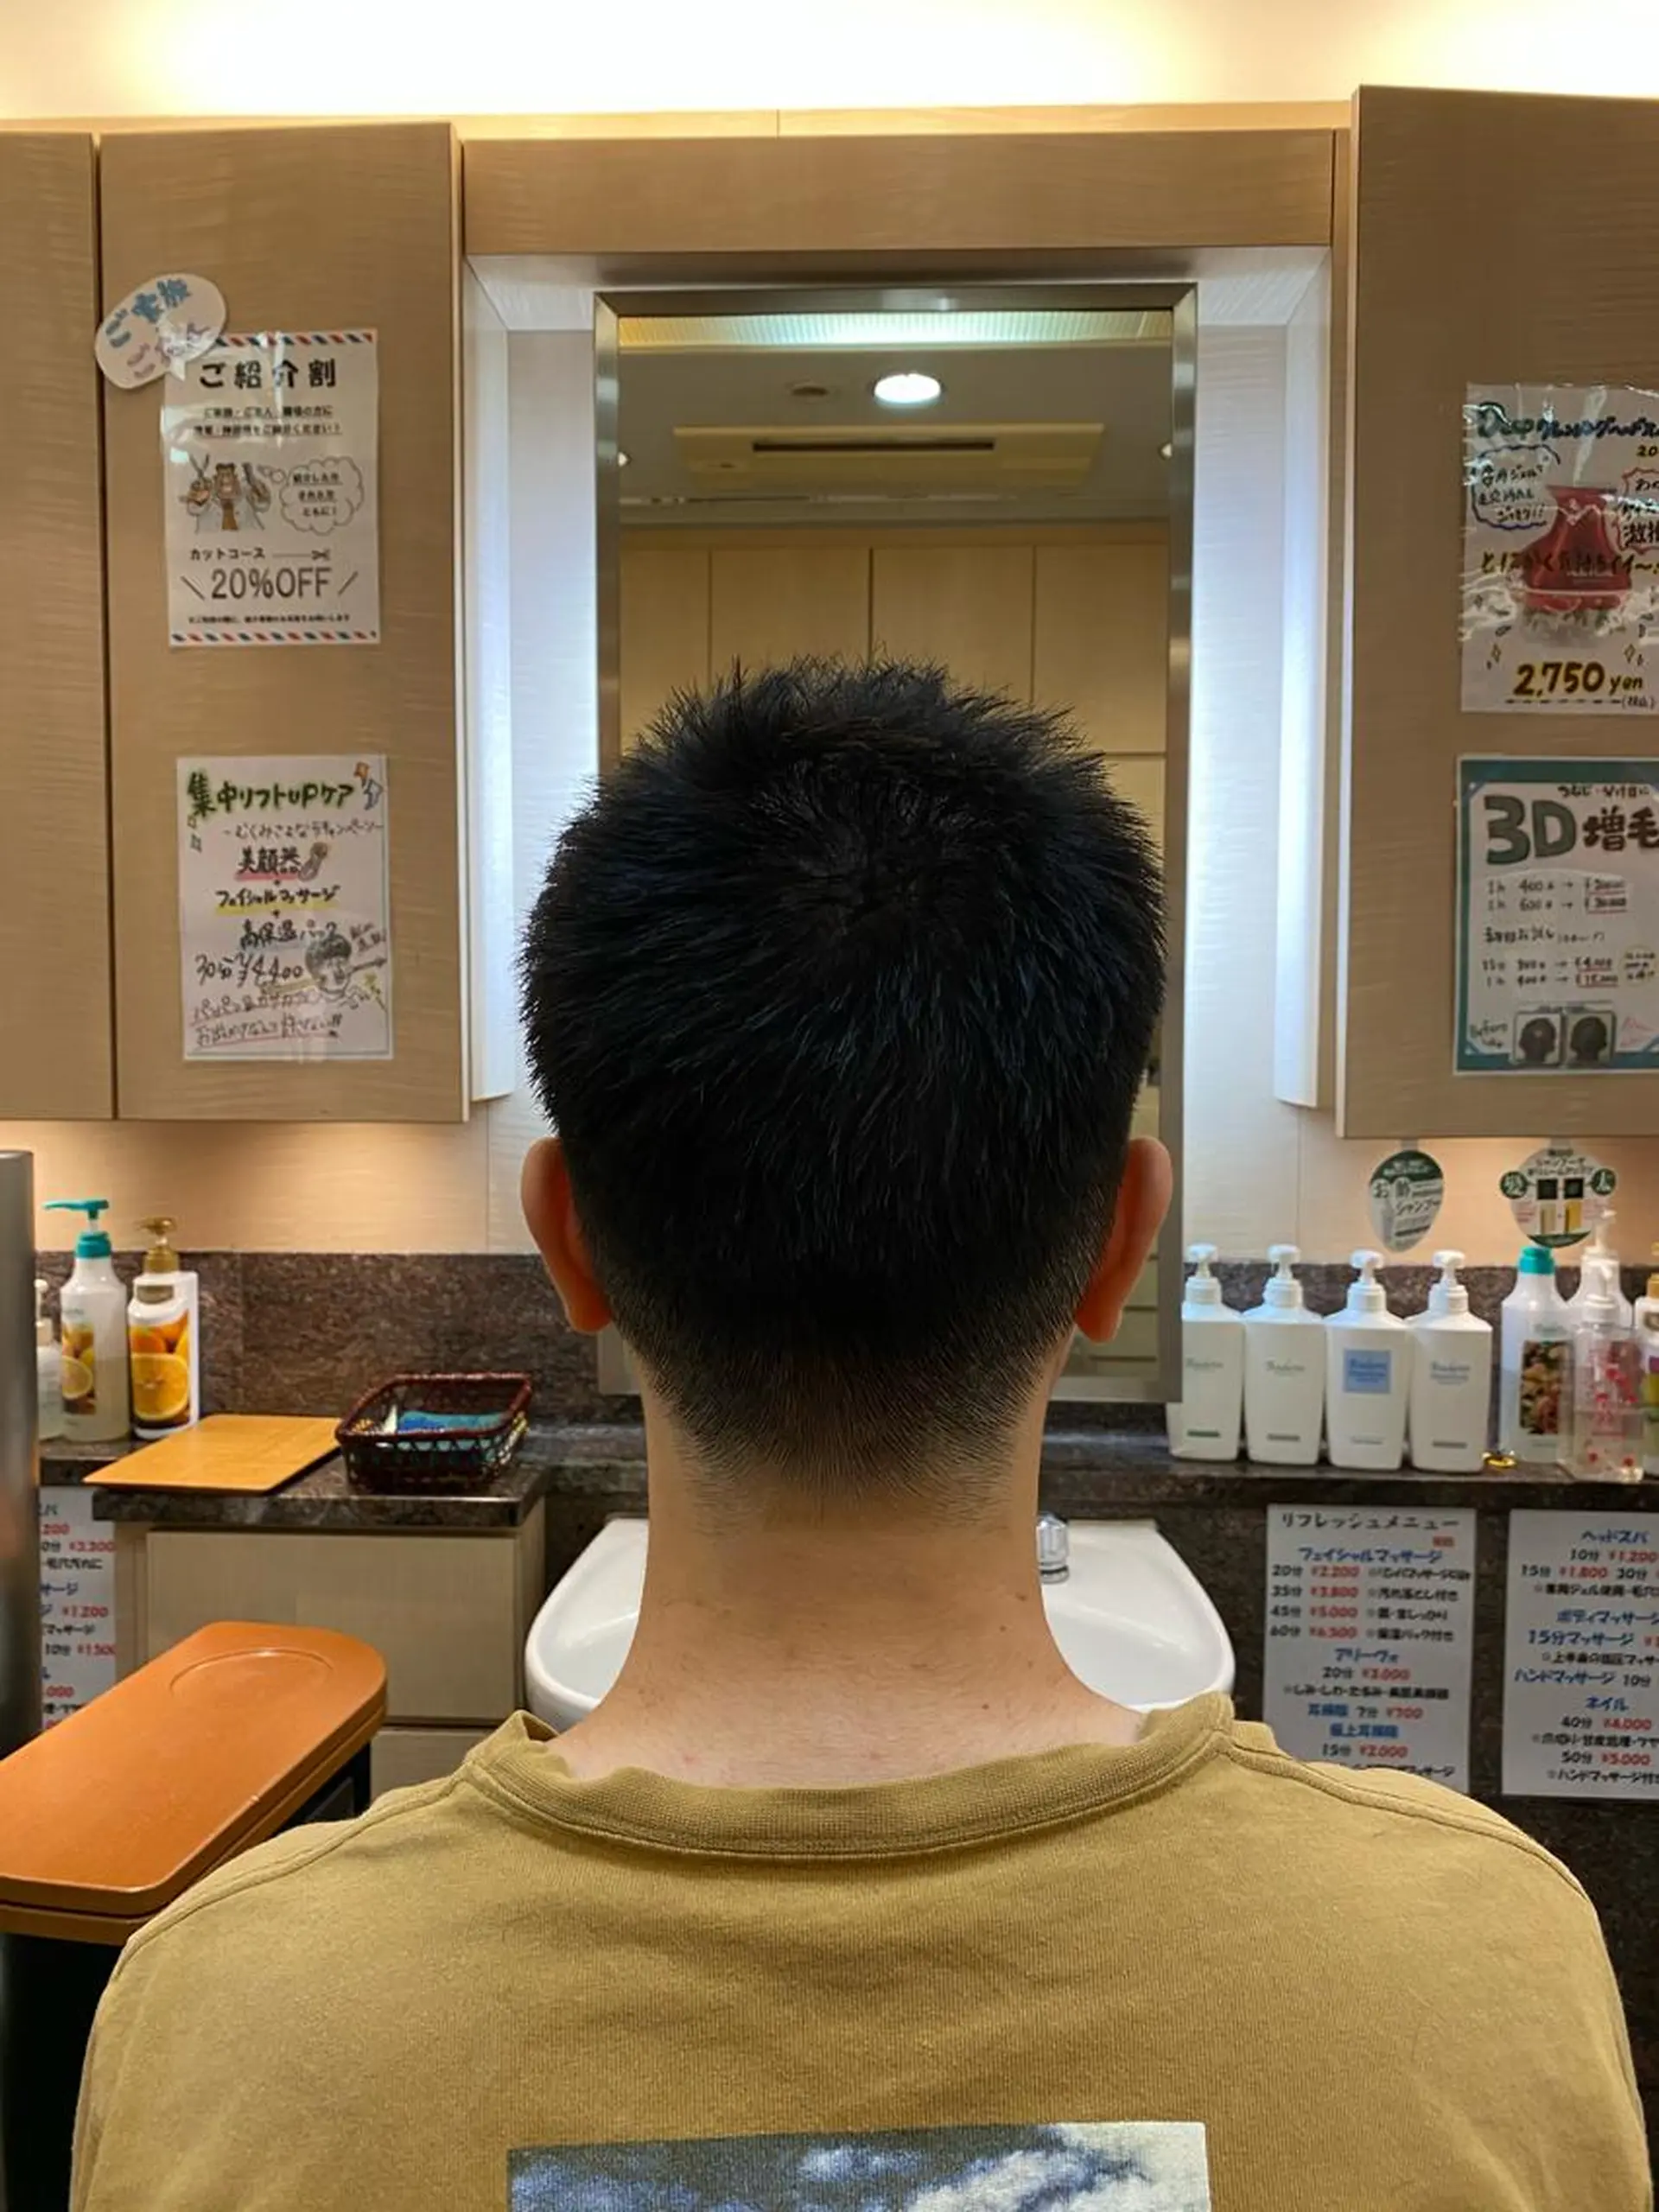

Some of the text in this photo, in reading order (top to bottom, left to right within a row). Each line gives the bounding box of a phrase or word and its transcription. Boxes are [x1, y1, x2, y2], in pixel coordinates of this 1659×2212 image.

[200, 359, 336, 389] ご紹介割
[190, 547, 266, 562] カットコース
[211, 567, 332, 600] 20%OFF
[1513, 660, 1643, 696] 2,750 yen
[237, 845, 302, 875] 美顔器
[1281, 1512, 1459, 1530] リフレッシュメニュー
[1298, 1546, 1443, 1564] フェイシャルマッサージ
[1272, 1564, 1303, 1578] 20分
[1270, 1585, 1302, 1598] 35分
[1269, 1605, 1302, 1618] 45分
[1269, 1624, 1301, 1637] 60分
[1322, 1666, 1354, 1680] 20分
[1514, 1668, 1617, 1685] ハンドマッサージ
[1585, 1696, 1630, 1713] ネイル
